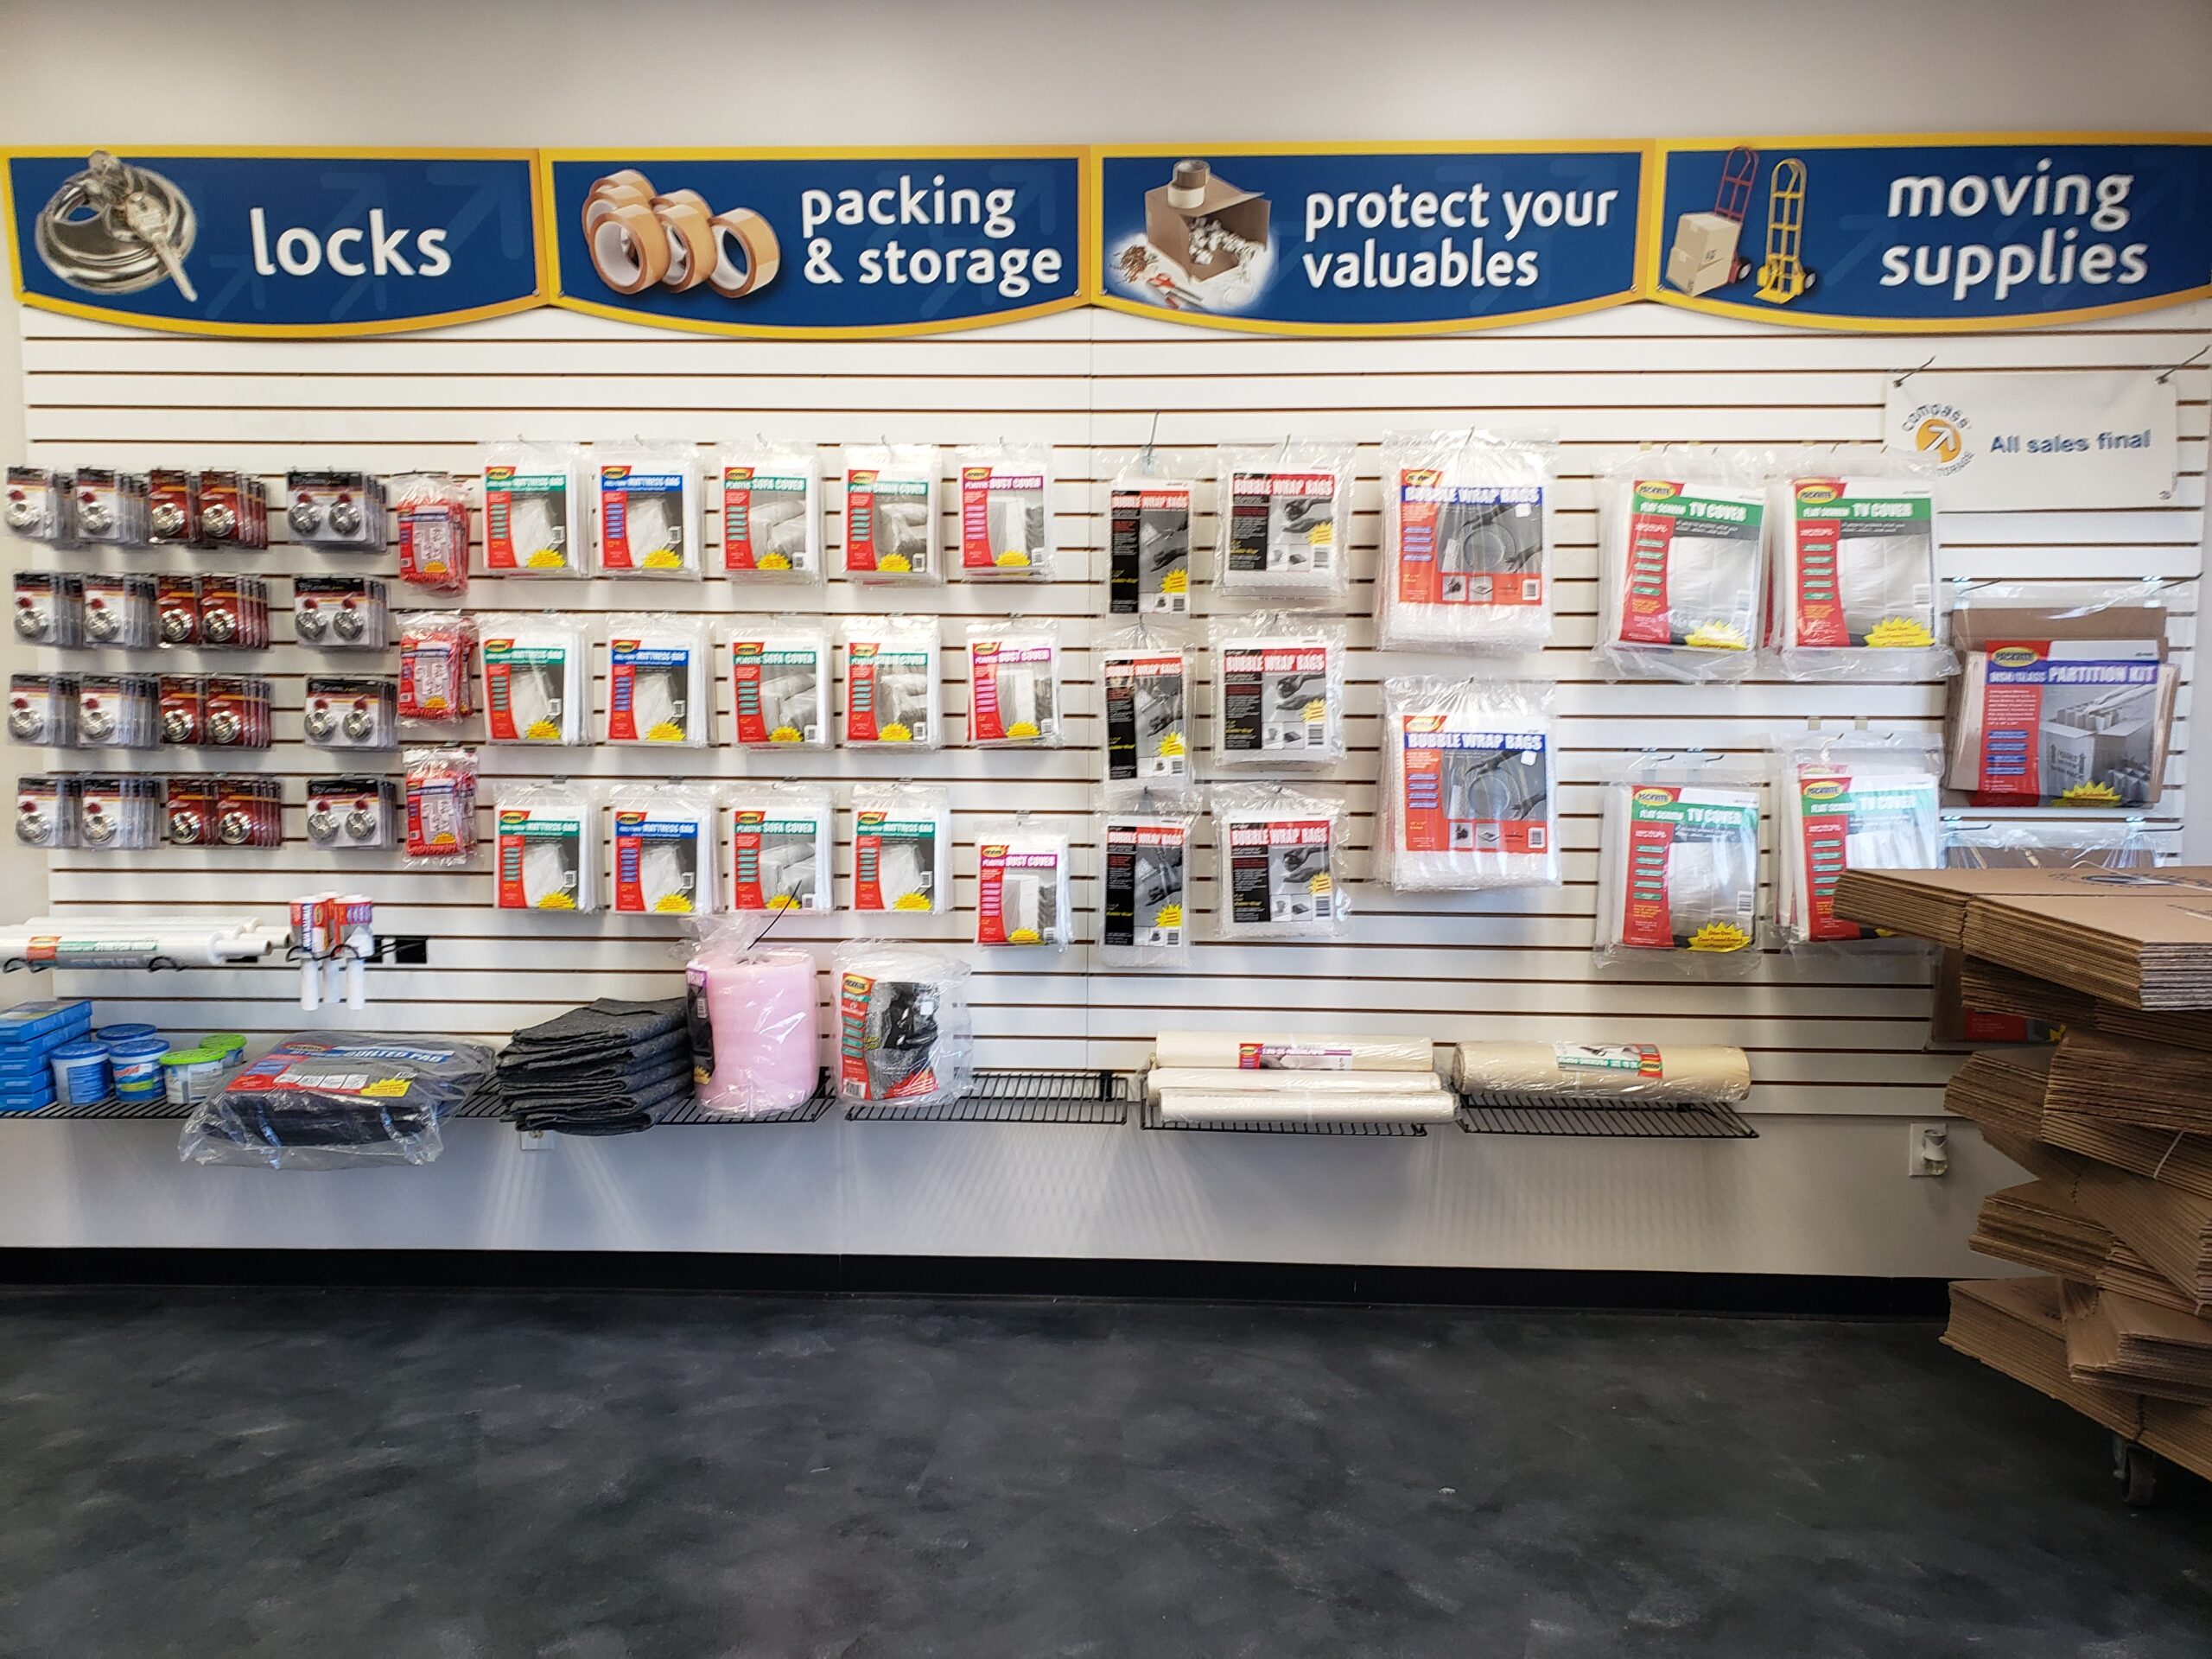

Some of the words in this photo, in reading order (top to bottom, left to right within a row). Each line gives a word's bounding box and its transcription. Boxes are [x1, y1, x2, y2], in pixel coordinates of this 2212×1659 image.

[802, 175, 1015, 240] packing
[1888, 158, 2133, 232] moving
[1306, 183, 1490, 242] protect
[1502, 190, 1618, 243] your
[251, 208, 450, 276] locks
[804, 238, 843, 284] &
[859, 232, 1062, 298] storage
[1302, 237, 1538, 289] valuables
[1879, 227, 2146, 302] supplies
[1902, 403, 1971, 432] compass
[1991, 435, 2019, 453] All
[2026, 434, 2090, 454] sales
[2096, 429, 2152, 450] final
[1936, 451, 1975, 477] TORAGE
[1688, 502, 1707, 516] TV
[1707, 505, 1747, 522] COVER
[1853, 503, 1871, 517] TV
[1871, 503, 1913, 517] COVER
[1226, 656, 1263, 671] BUBBLE
[1264, 655, 1296, 671] WRAP
[1296, 653, 1325, 671] BAGS
[2049, 664, 2127, 683] PARTITION
[2128, 665, 2157, 682] KIT
[1408, 733, 1462, 748] BUBBLE
[1462, 734, 1504, 749] WRAP
[1504, 734, 1542, 750] BAGS
[1687, 808, 1705, 821] TV
[1705, 809, 1743, 824] COVER
[1231, 830, 1269, 845] BUBBLE
[1269, 828, 1300, 844] WRAP
[1300, 826, 1327, 843] BAGS
[344, 1049, 406, 1058] QUILTED
[408, 1052, 445, 1064] PAD
